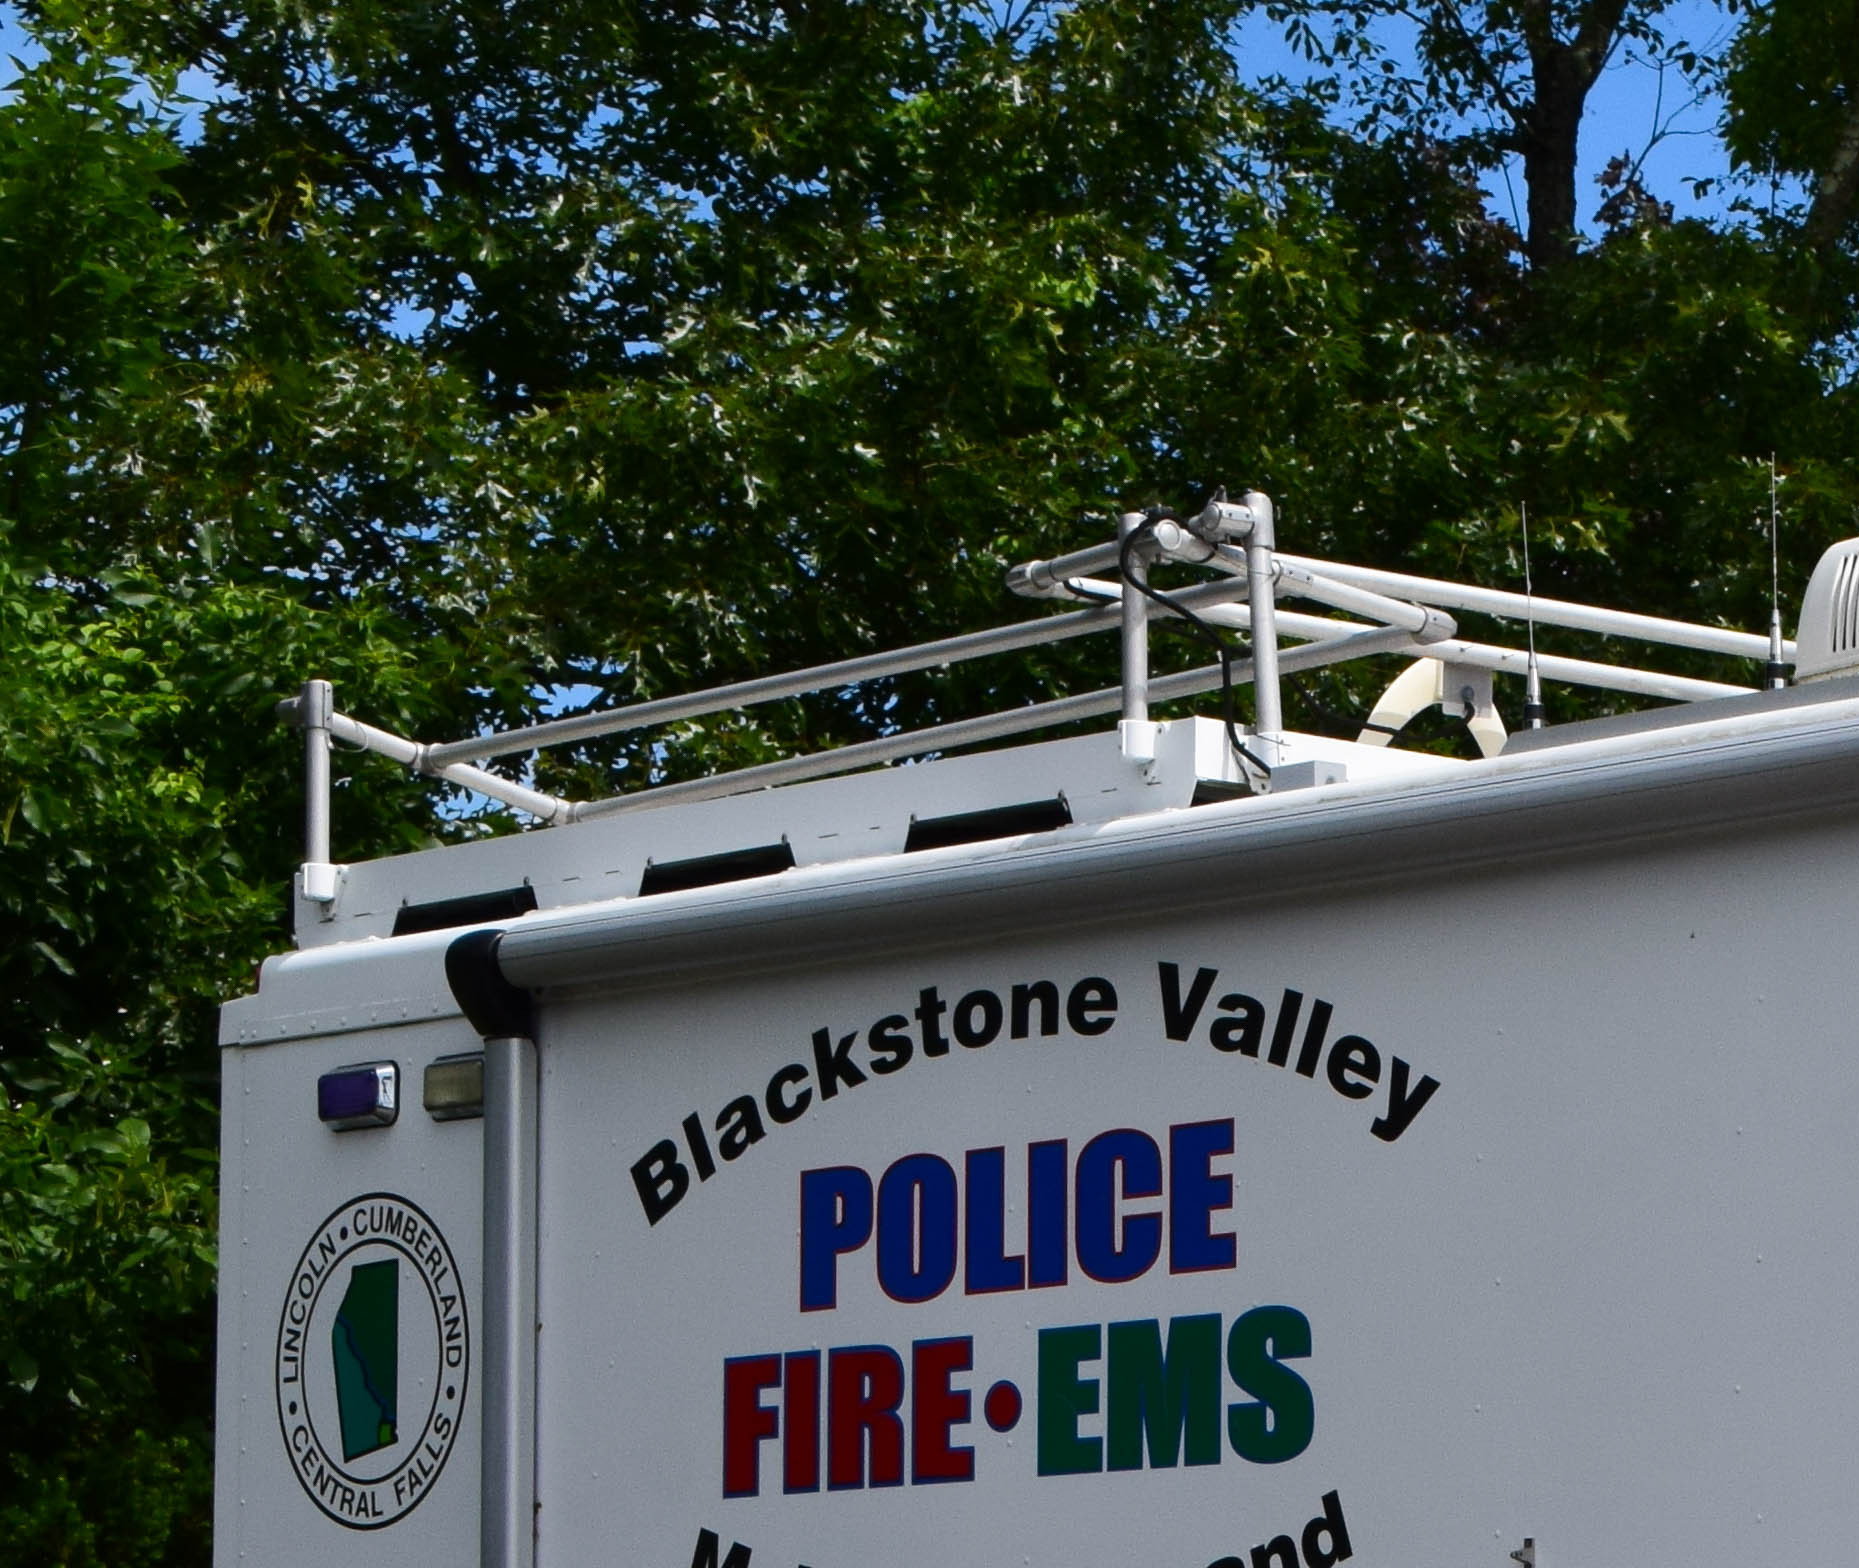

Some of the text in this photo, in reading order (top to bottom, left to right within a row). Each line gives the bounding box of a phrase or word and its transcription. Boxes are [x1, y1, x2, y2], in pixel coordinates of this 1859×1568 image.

[630, 961, 1441, 1227] Blackstone Valley
[282, 1205, 463, 1384] LINCOLN CUMBERLAND
[799, 1118, 1237, 1312] POLICE
[292, 1412, 452, 1519] CENTRAL FALLS
[723, 1305, 1315, 1498] FIRE EMS
